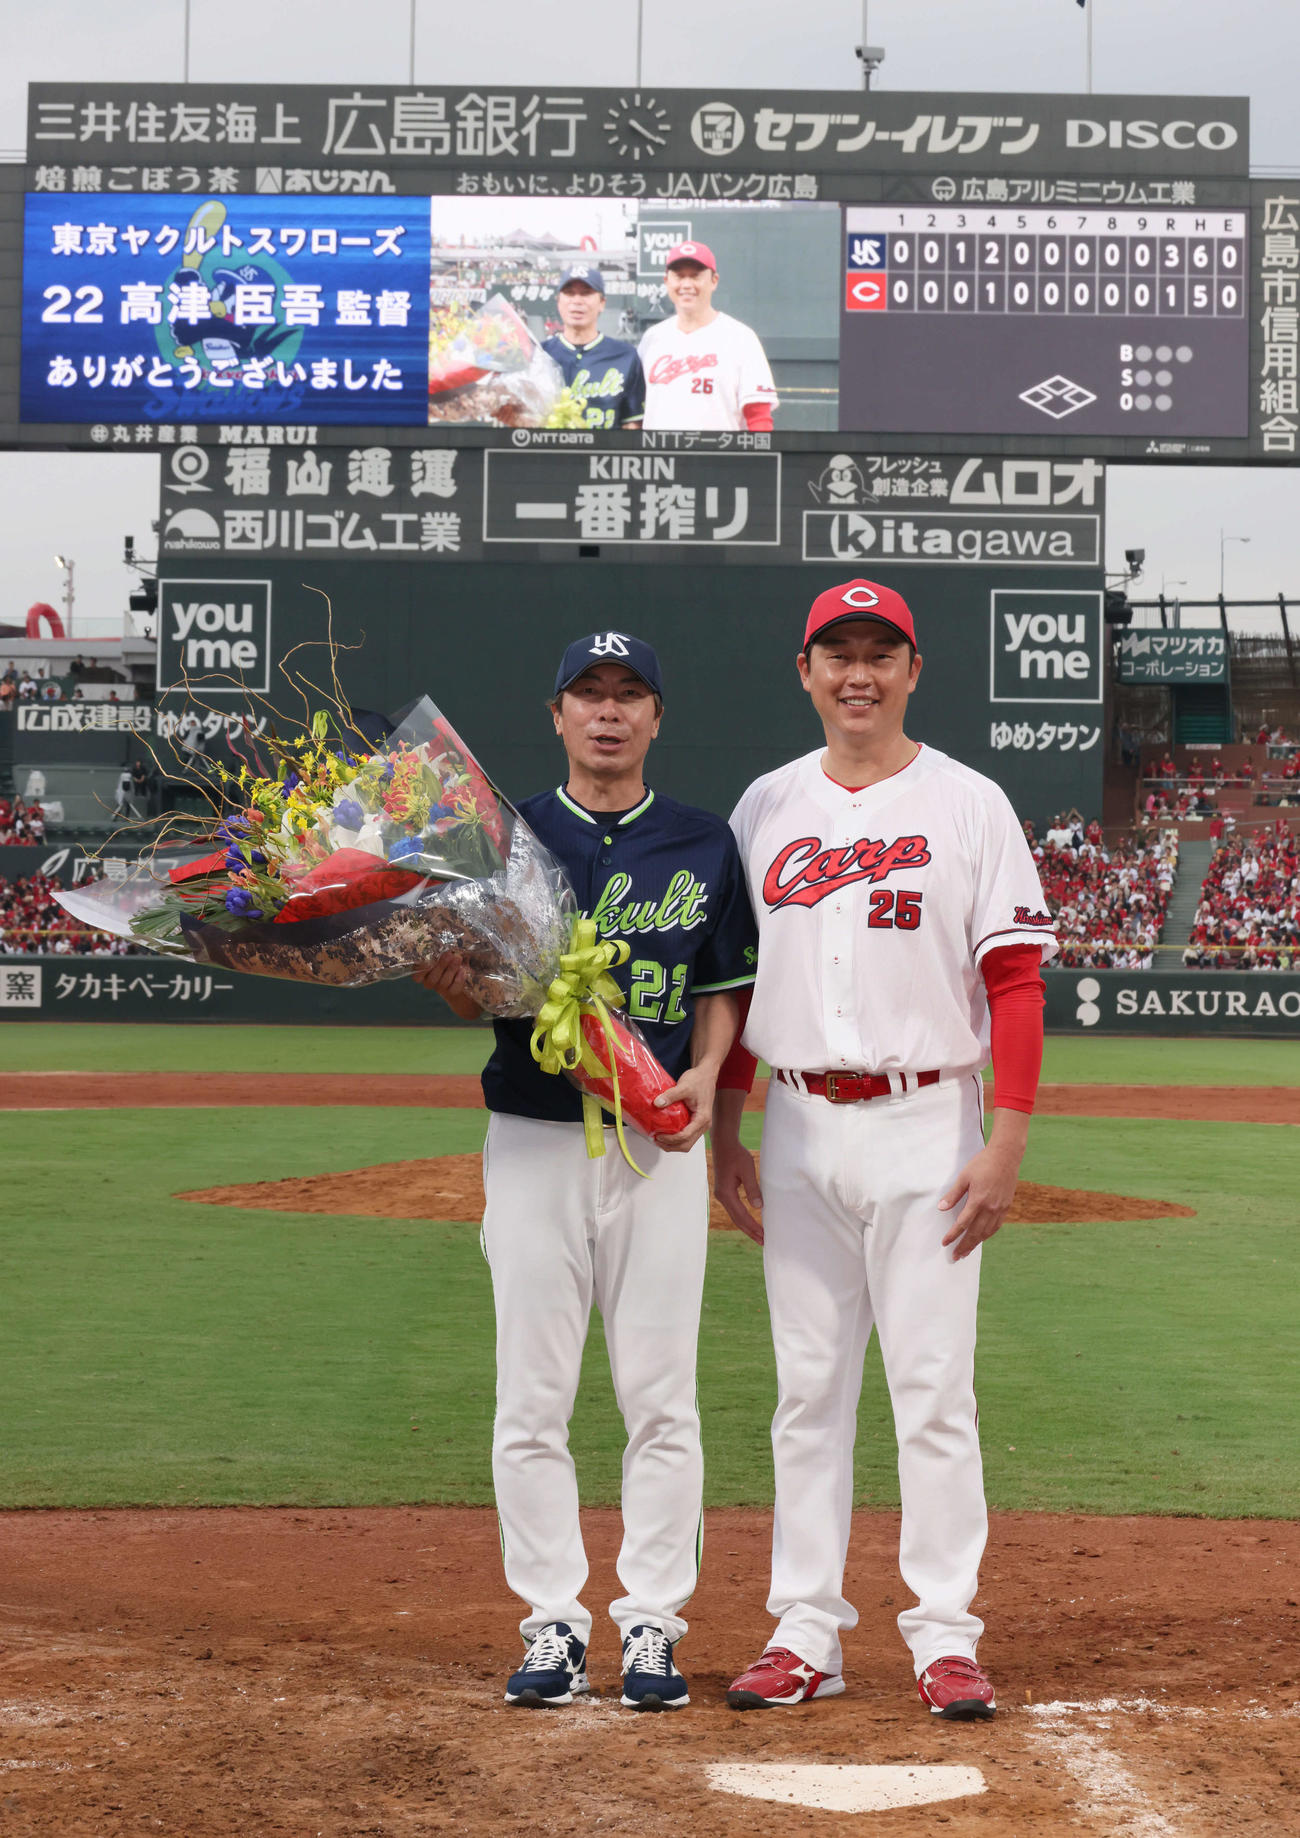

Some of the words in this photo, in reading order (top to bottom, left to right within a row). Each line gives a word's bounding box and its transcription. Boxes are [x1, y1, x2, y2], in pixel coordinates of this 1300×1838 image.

[35, 102, 302, 144] 三井住友海上
[322, 91, 588, 157] 広島銀行
[1066, 119, 1239, 150] DISCO
[35, 166, 240, 193] 焙煎ごぼう茶
[284, 169, 397, 193] あじかん
[457, 173, 646, 196] おもいに、よりそう
[656, 173, 818, 200] JAバンク広島
[961, 178, 1196, 205] 広島アルミニウム工業
[898, 213, 904, 227] 1
[927, 214, 936, 228] 2
[957, 214, 967, 228] 3
[987, 215, 996, 228] 4
[1017, 215, 1027, 229] 5
[1047, 216, 1057, 229] 6
[1077, 216, 1087, 229] 7
[1107, 216, 1117, 230] 8
[1137, 217, 1148, 231] 9
[1166, 218, 1175, 230] R
[1195, 219, 1206, 231] H
[1224, 218, 1232, 232] E
[51, 223, 404, 256] 東京ヤクルトスワローズ
[893, 240, 909, 263] 0
[923, 240, 939, 264] 0
[956, 241, 966, 264] 1
[984, 241, 1000, 265] 2
[1014, 241, 1030, 265] 0
[1044, 242, 1060, 266] 0
[1074, 242, 1090, 266] 0
[1104, 243, 1120, 267] 0
[1134, 243, 1150, 267] 0
[1164, 244, 1180, 268] 3
[1193, 244, 1209, 268] 6
[1222, 245, 1237, 269] 0
[41, 285, 104, 324] 22
[120, 281, 212, 326] 高津
[234, 283, 325, 327] 臣吾
[335, 290, 411, 326] 監督
[893, 280, 909, 303] 0
[923, 280, 939, 304] 0
[953, 280, 969, 304] 0
[985, 281, 995, 304] 1
[1013, 281, 1029, 305] 0
[1044, 282, 1060, 306] 0
[1074, 282, 1090, 306] 0
[1104, 283, 1120, 307] 0
[1134, 283, 1150, 307] 0
[1165, 284, 1176, 307] 1
[1193, 284, 1208, 308] 5
[1221, 285, 1237, 309] 0
[1260, 195, 1300, 452] 広島市信用組合
[1119, 344, 1134, 362] B
[46, 355, 403, 390] ありがとうございました
[1121, 368, 1134, 387] S
[112, 425, 198, 443] 丸井産業
[218, 426, 318, 444] MARUI
[532, 433, 557, 444] NTT
[224, 447, 457, 498] 福山通運
[589, 456, 675, 480] KIRIN
[866, 456, 942, 474] フレッシュ
[872, 477, 949, 497] 創造企業
[949, 458, 1104, 506] ムロオ
[515, 483, 750, 540] 一番搾り
[223, 509, 461, 552] 西川ゴム工業
[171, 602, 253, 641] you
[1004, 612, 1086, 652] you
[187, 639, 257, 668] me
[1152, 637, 1225, 655] マツオカ
[1020, 649, 1090, 679] me
[1121, 660, 1225, 677] コーポレーション
[17, 704, 152, 732] 広成建設
[990, 722, 1100, 751] ゆめタウン
[763, 835, 931, 914] Carp
[867, 889, 923, 931] 25
[6, 971, 36, 1001] 窯
[54, 973, 234, 1001] タカキベーカリー
[628, 959, 689, 1025] 22
[1116, 989, 1300, 1017] SAKURAO
